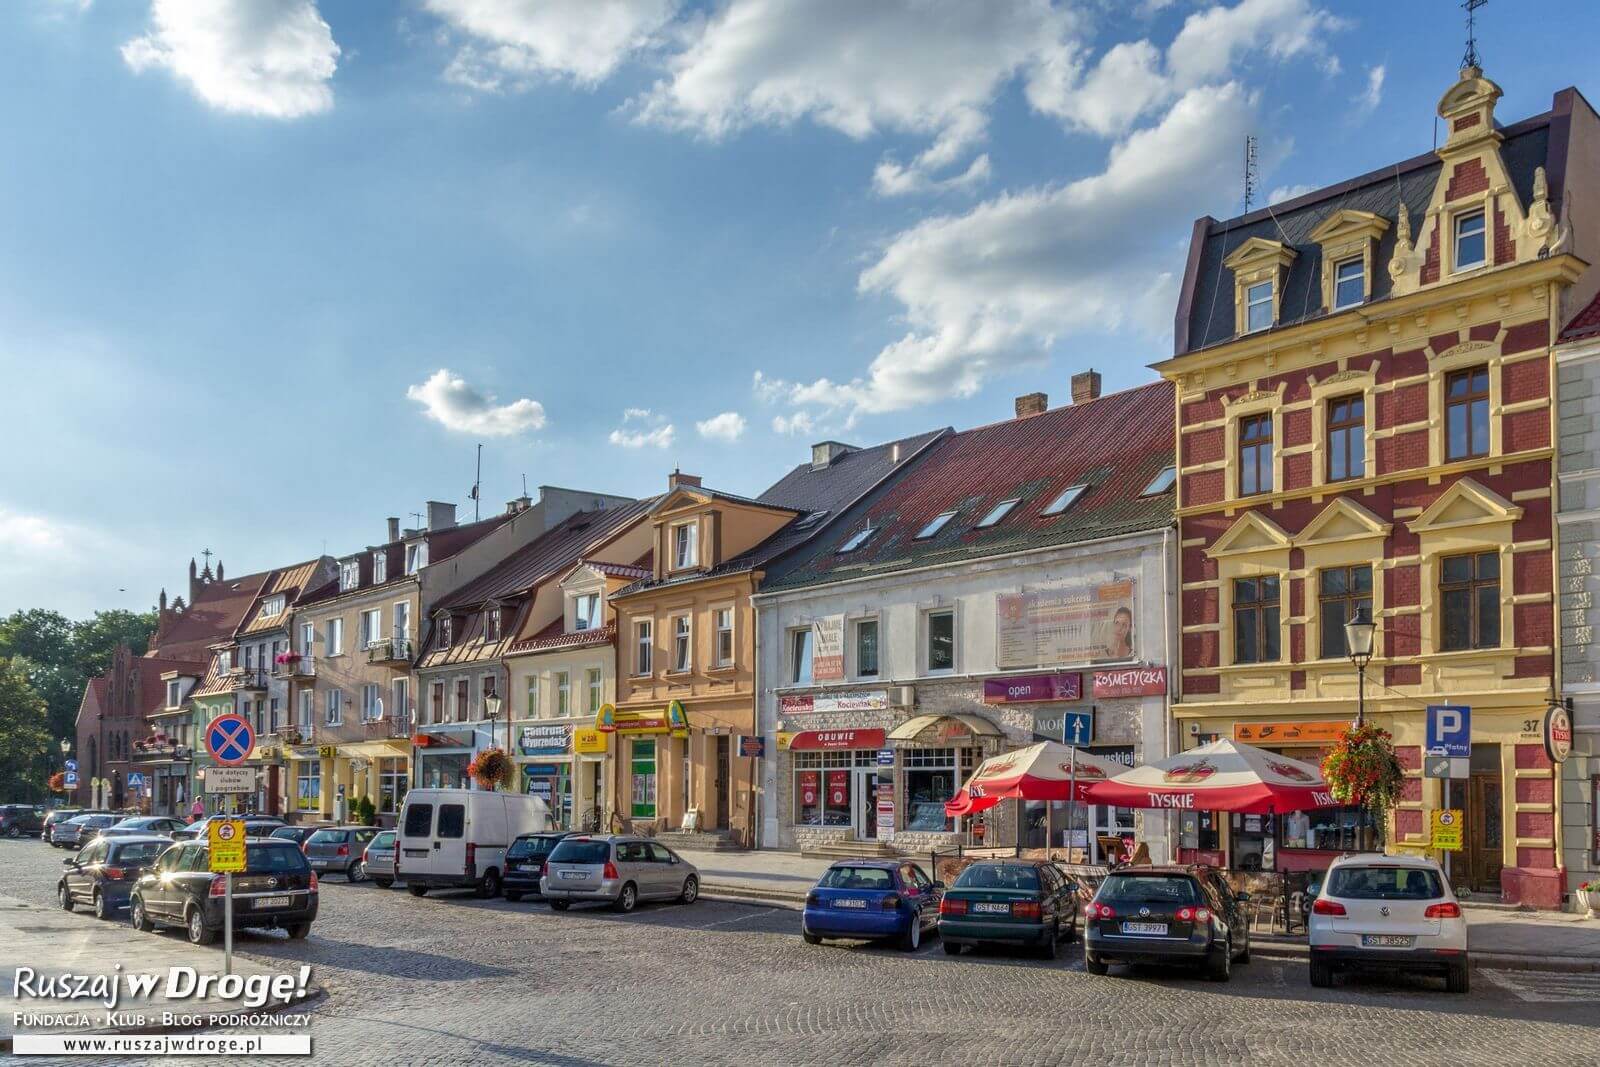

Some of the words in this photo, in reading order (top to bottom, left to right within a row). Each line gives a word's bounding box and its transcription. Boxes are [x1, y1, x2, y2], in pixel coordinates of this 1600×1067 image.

[1095, 670, 1164, 687] KOSMETYCZKA
[1008, 685, 1031, 698] open
[524, 726, 565, 736] Centrum
[1436, 710, 1461, 741] P
[1523, 719, 1540, 732] 37
[818, 732, 855, 741] OBUWIE
[226, 769, 248, 777] dotyczy
[1148, 792, 1195, 809] TYSKIE
